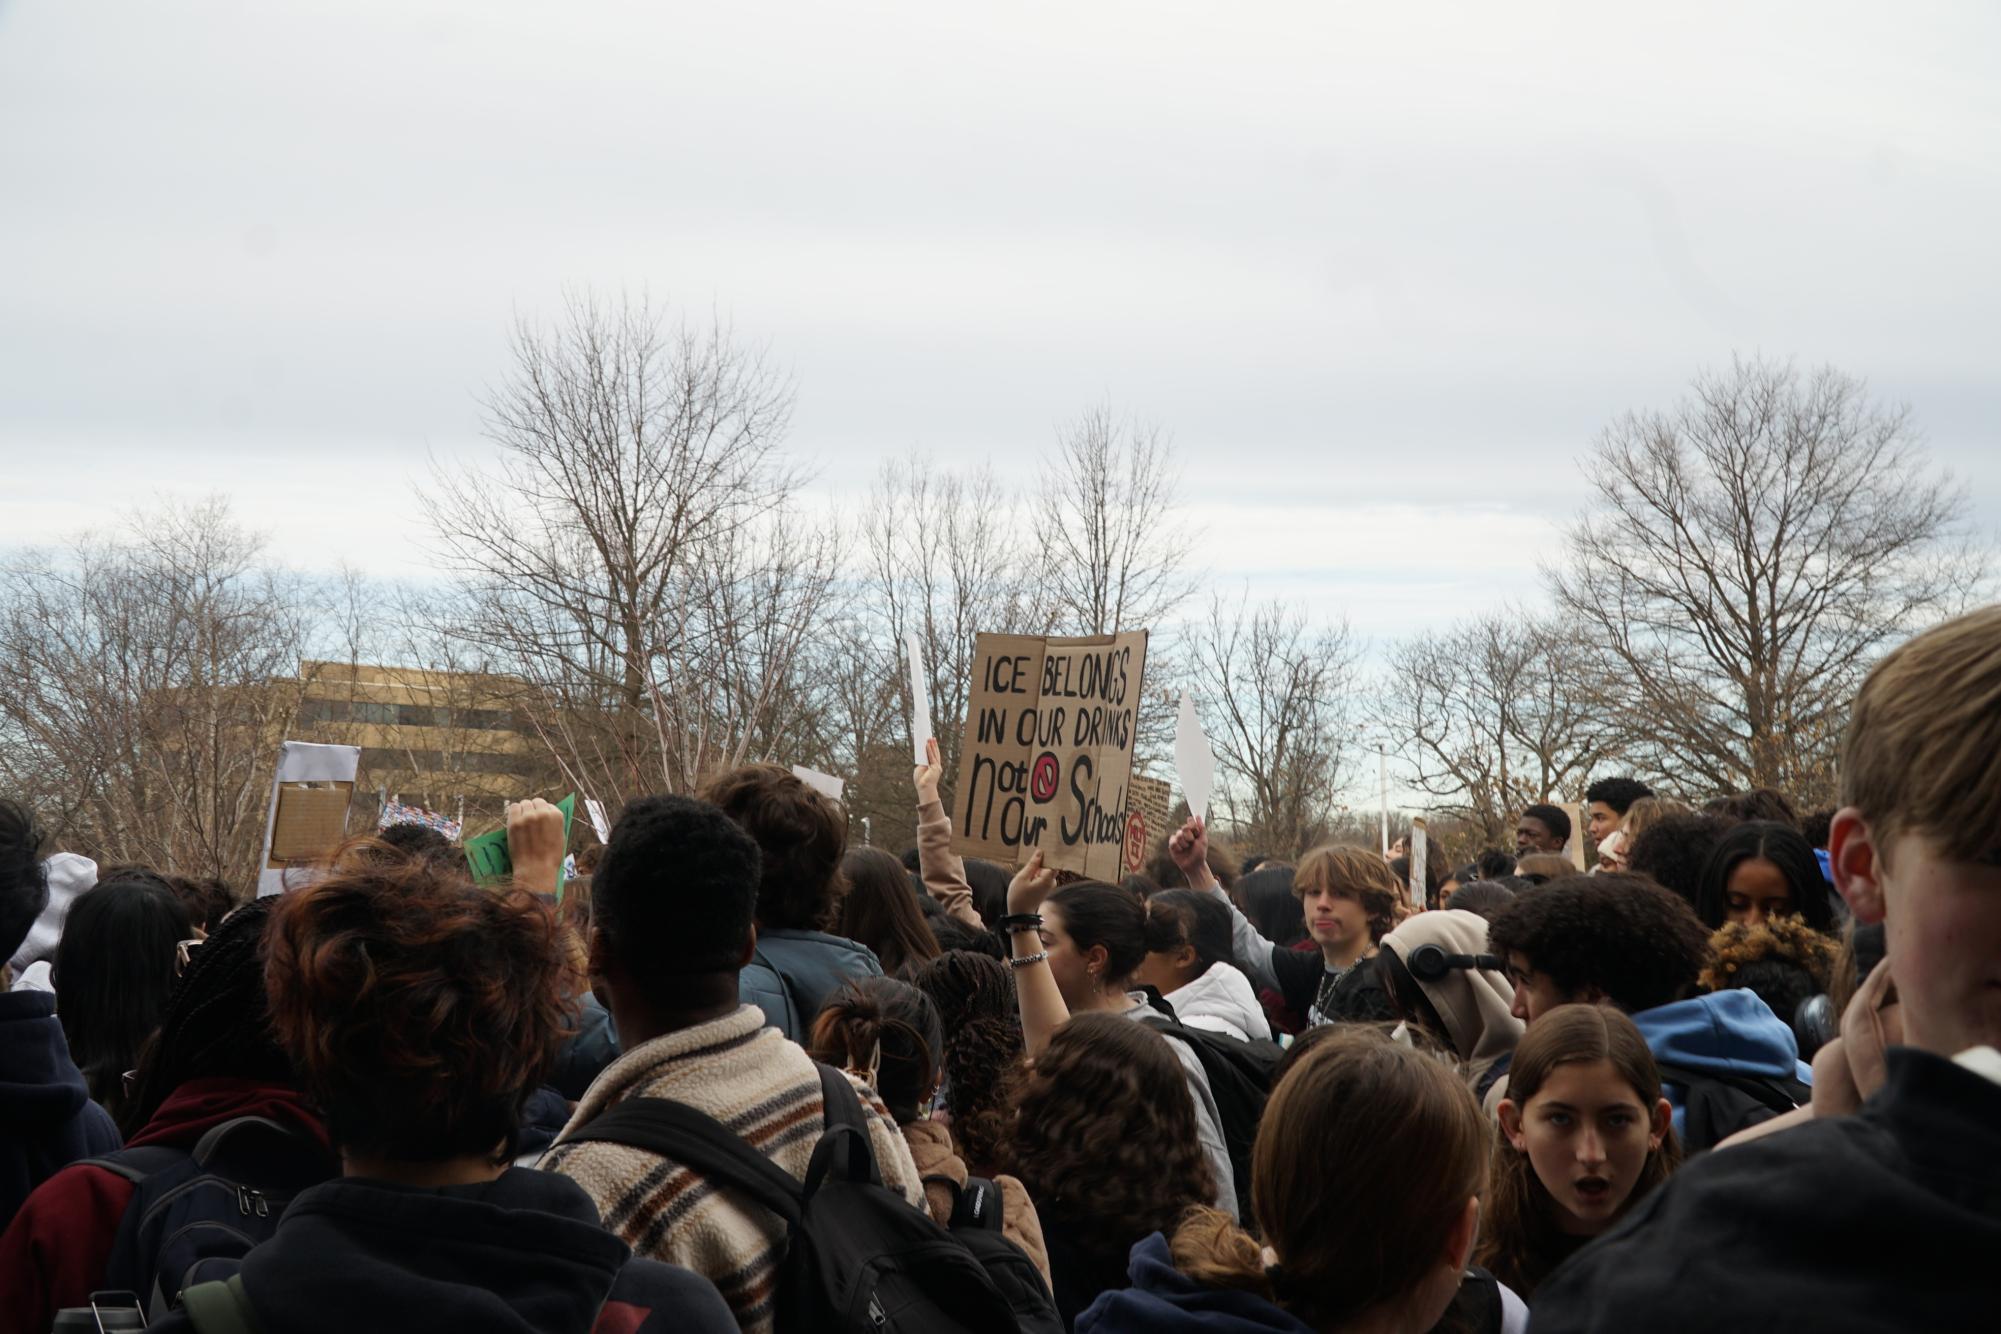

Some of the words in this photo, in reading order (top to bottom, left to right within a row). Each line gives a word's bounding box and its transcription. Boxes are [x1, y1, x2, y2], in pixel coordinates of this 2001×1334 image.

[984, 655, 1031, 693] ICE
[1041, 646, 1130, 706] BELONGS
[978, 707, 1006, 744] IN
[1016, 706, 1066, 747] OUR
[1074, 706, 1131, 750] DRINKS
[1000, 797, 1047, 847] Our
[1061, 754, 1124, 845] Schools
